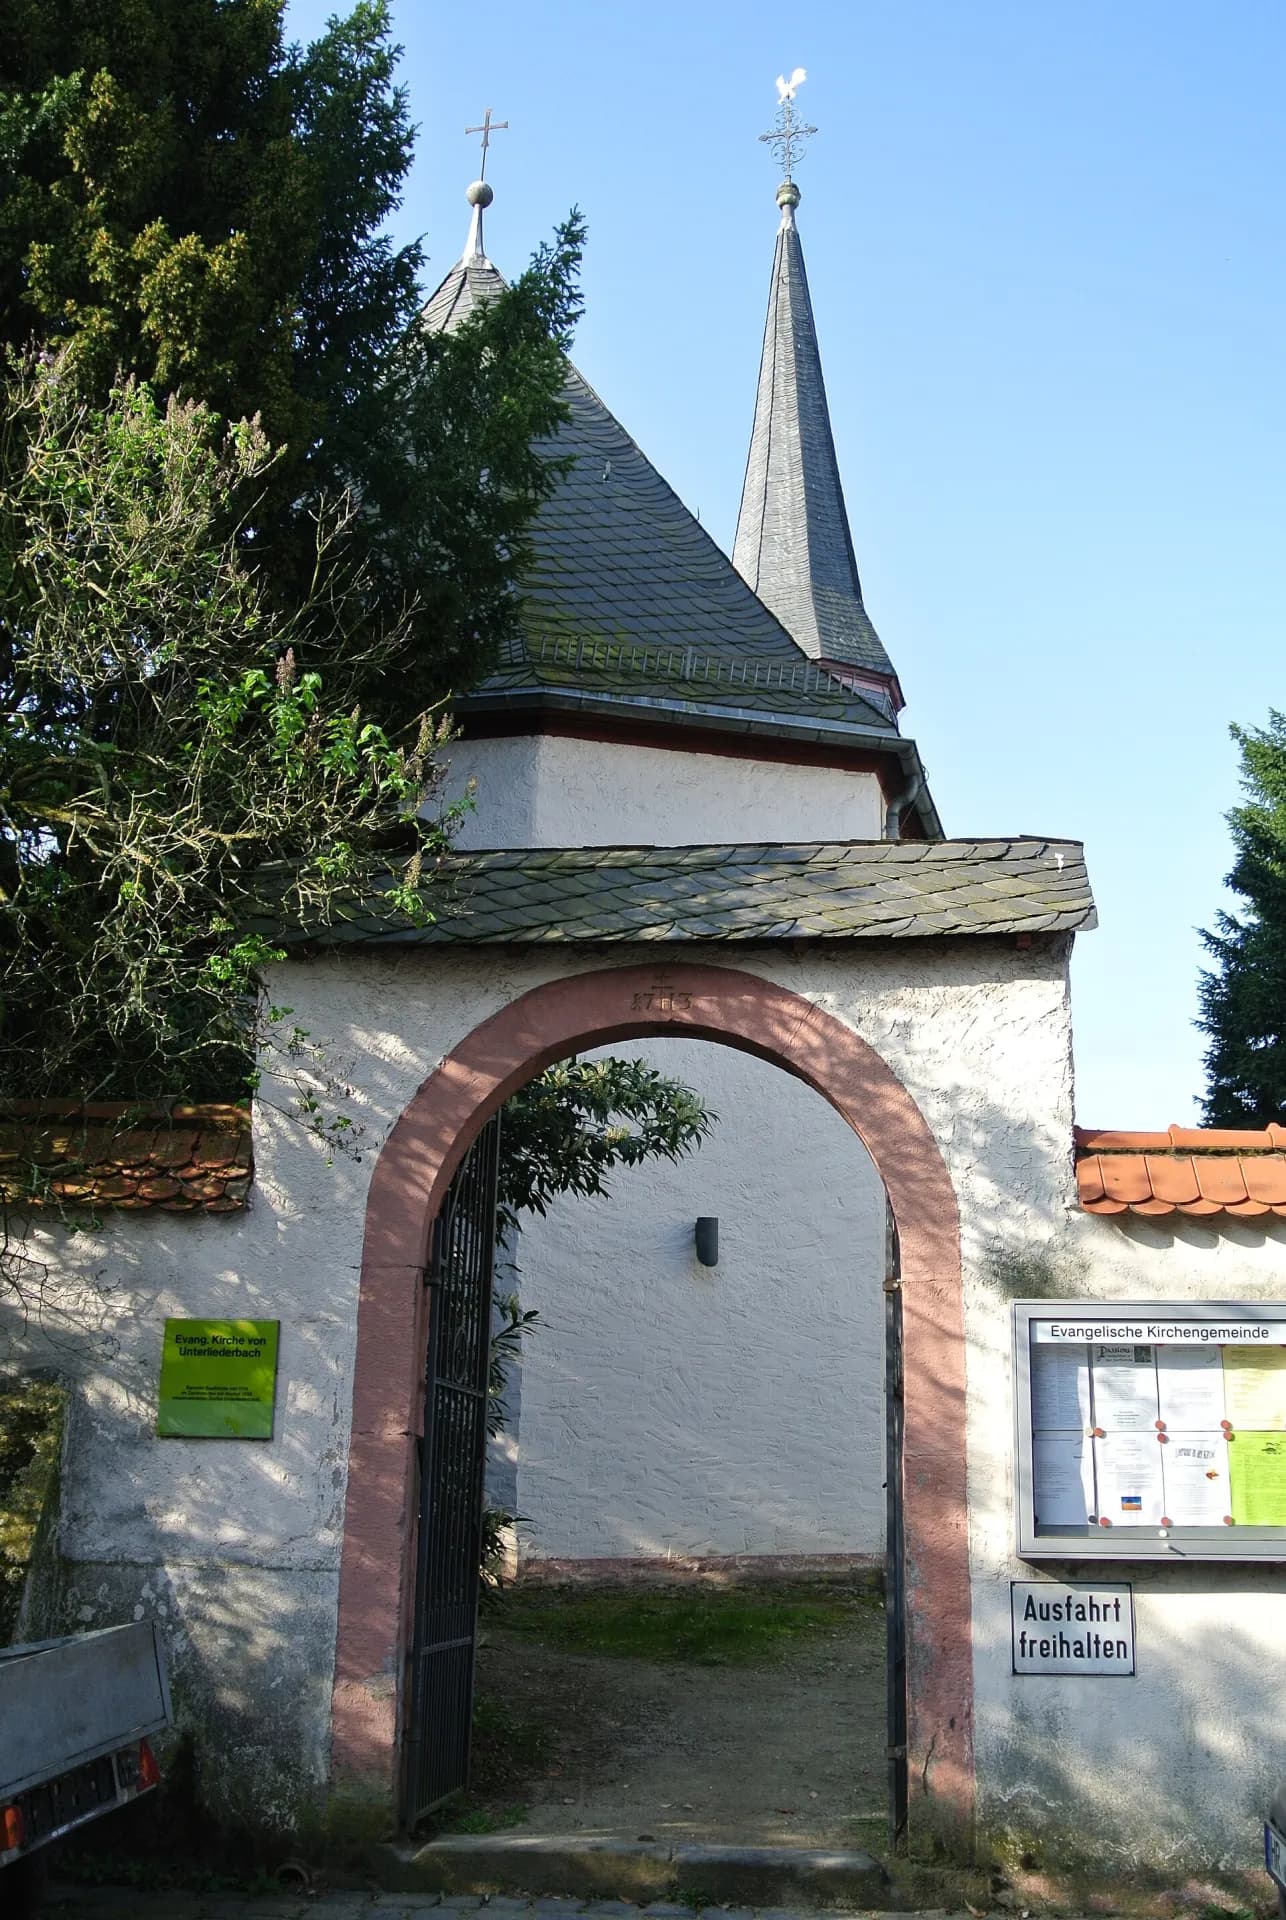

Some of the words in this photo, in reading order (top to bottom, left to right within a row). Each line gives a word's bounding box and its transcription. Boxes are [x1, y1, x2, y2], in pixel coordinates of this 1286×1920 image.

[175, 1334, 210, 1346] Evang.
[211, 1335, 245, 1345] Kirche
[247, 1337, 267, 1346] von
[1050, 1325, 1143, 1341] Evangelische
[1146, 1325, 1270, 1341] Kirchengemeinde
[179, 1347, 261, 1357] Unterliederbach
[1023, 1594, 1121, 1622] Ausfahrt
[1019, 1631, 1128, 1659] freihalten
